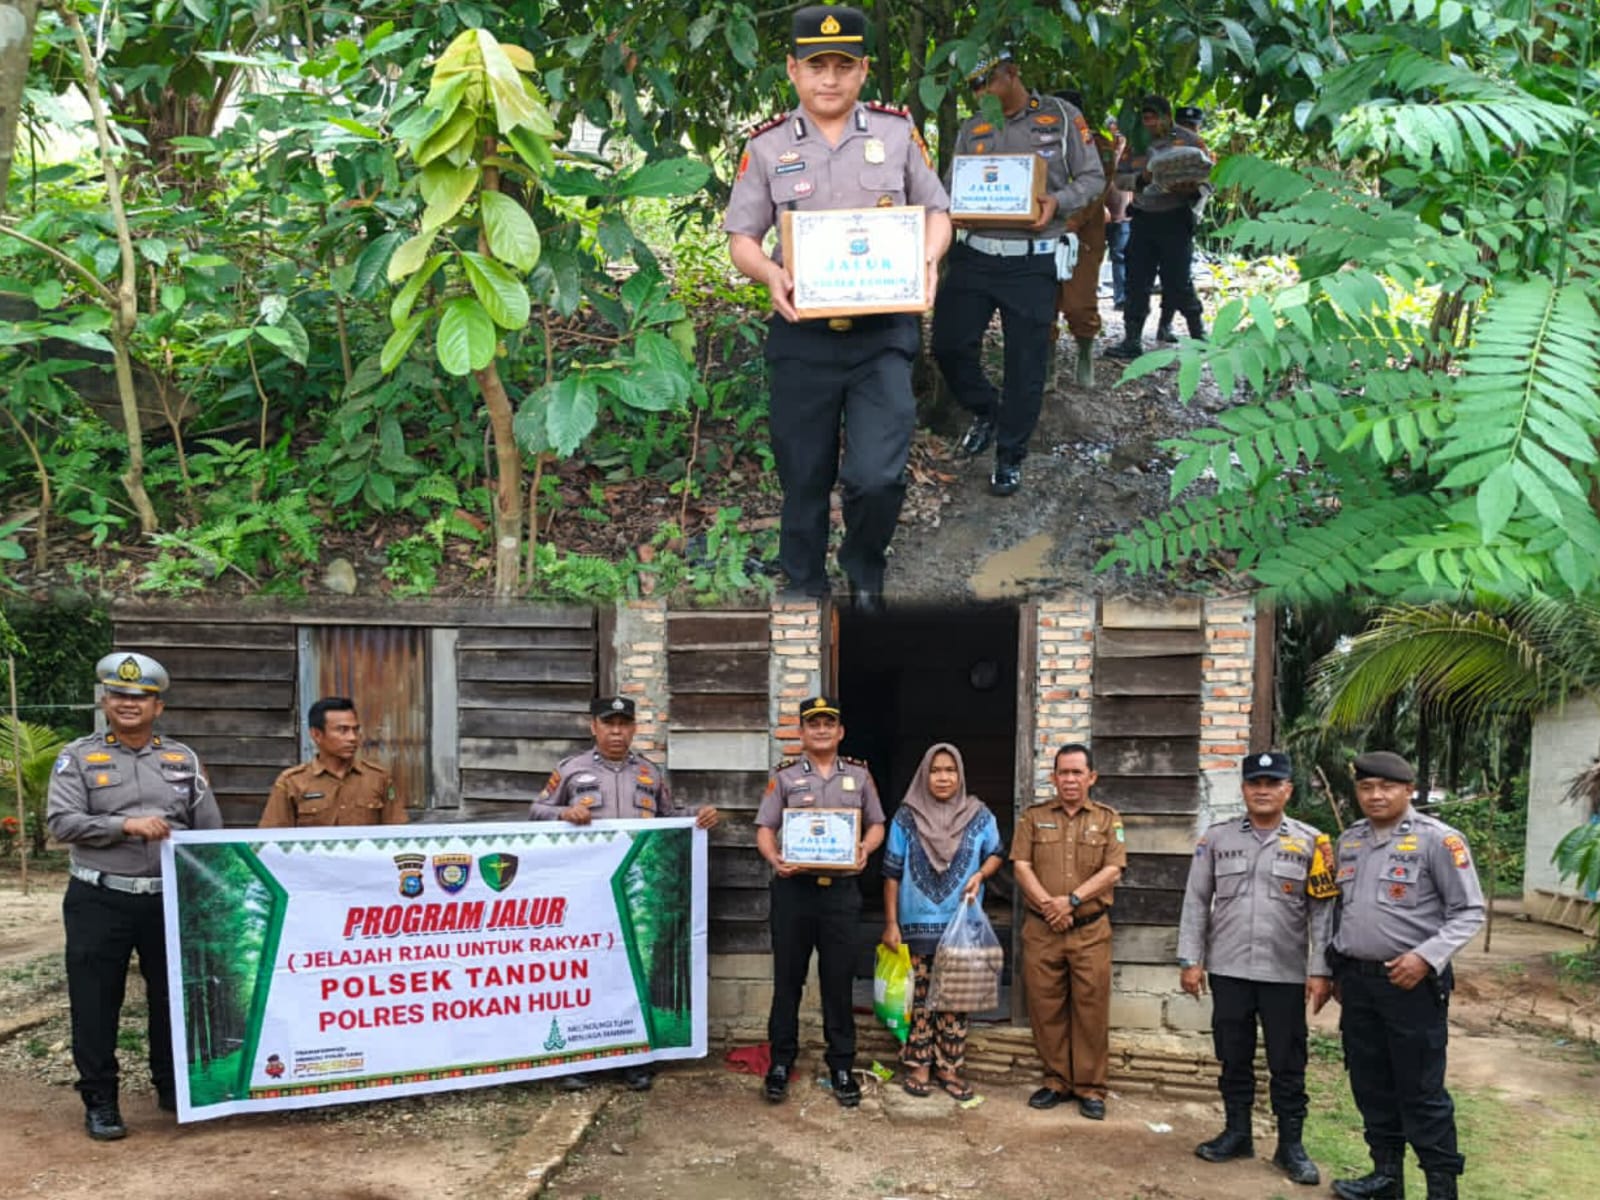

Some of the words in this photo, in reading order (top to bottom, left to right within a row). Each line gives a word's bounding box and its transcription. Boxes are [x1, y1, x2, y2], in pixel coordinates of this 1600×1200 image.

[968, 183, 1011, 192] JALUR
[825, 257, 893, 273] JALUR
[342, 900, 487, 940] PROGRAM
[486, 896, 568, 931] JALUR
[303, 947, 392, 968] JELAJAH
[399, 943, 451, 962] RIAU
[456, 937, 524, 958] UNTUK
[529, 932, 602, 952] RAKYAT
[320, 969, 453, 1001] POLSEK
[464, 958, 589, 988] TANDUN
[319, 1003, 425, 1032] POLRES
[432, 994, 522, 1022] ROKAN
[528, 987, 591, 1013] HULU
